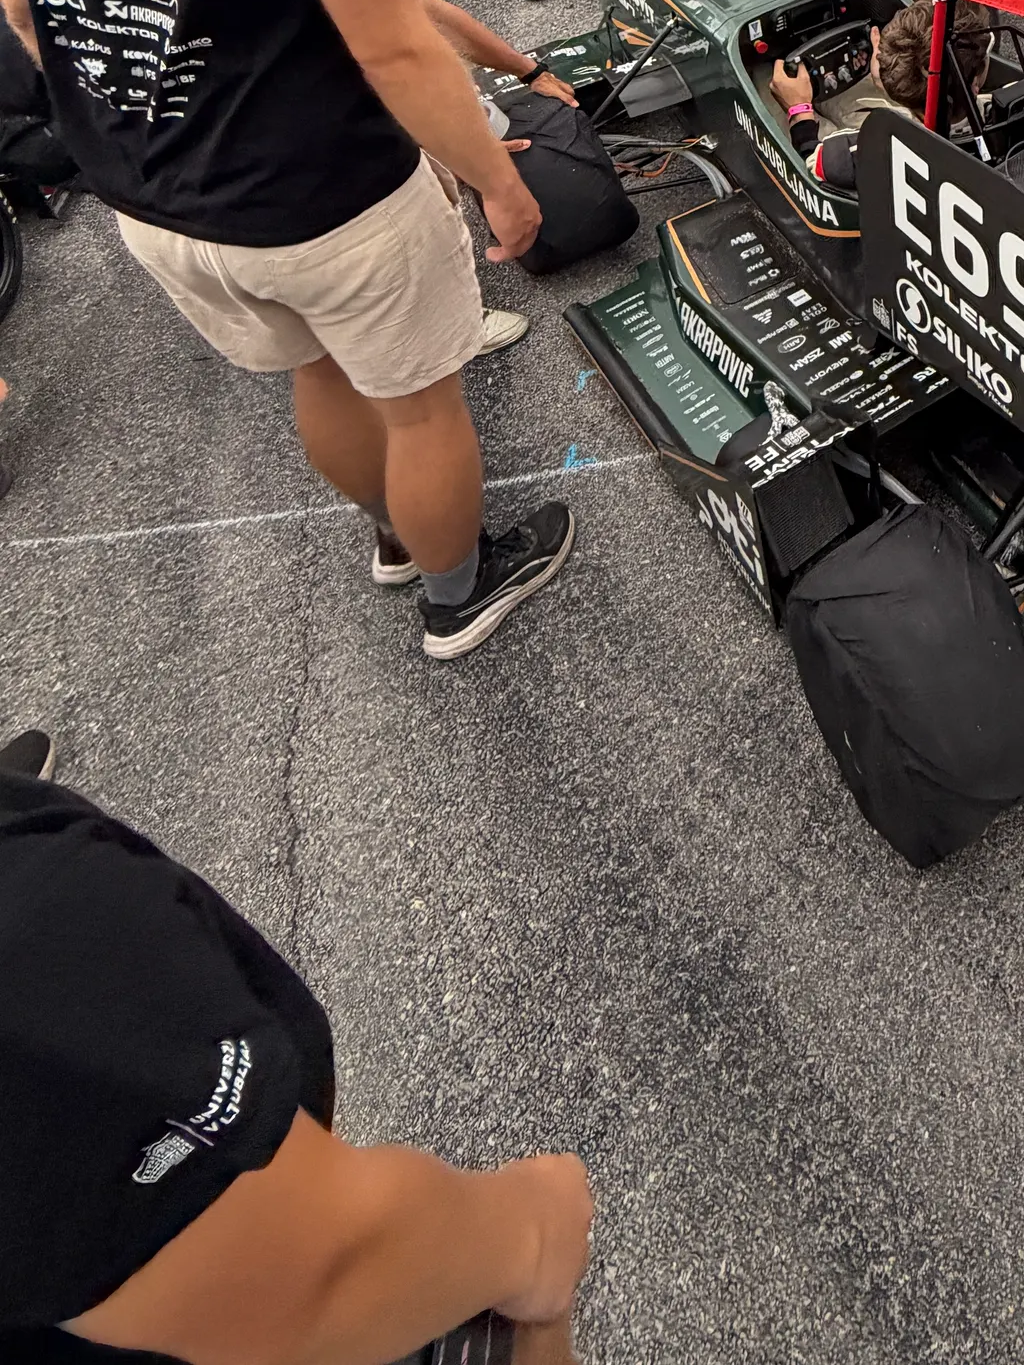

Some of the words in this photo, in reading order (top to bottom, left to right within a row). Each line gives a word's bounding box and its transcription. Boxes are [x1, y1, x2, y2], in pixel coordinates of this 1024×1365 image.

[77, 16, 159, 42] KOLEKTOR
[170, 37, 213, 54] SILIKO
[734, 100, 754, 140] UNI
[754, 125, 839, 227] LJUBLJANA
[681, 302, 754, 398] AKRAPOVIČ
[896, 322, 919, 356] FS
[789, 347, 825, 371] ZSAM
[932, 317, 1013, 404] SILIKO
[913, 367, 936, 382] RS
[745, 447, 779, 472] FE
